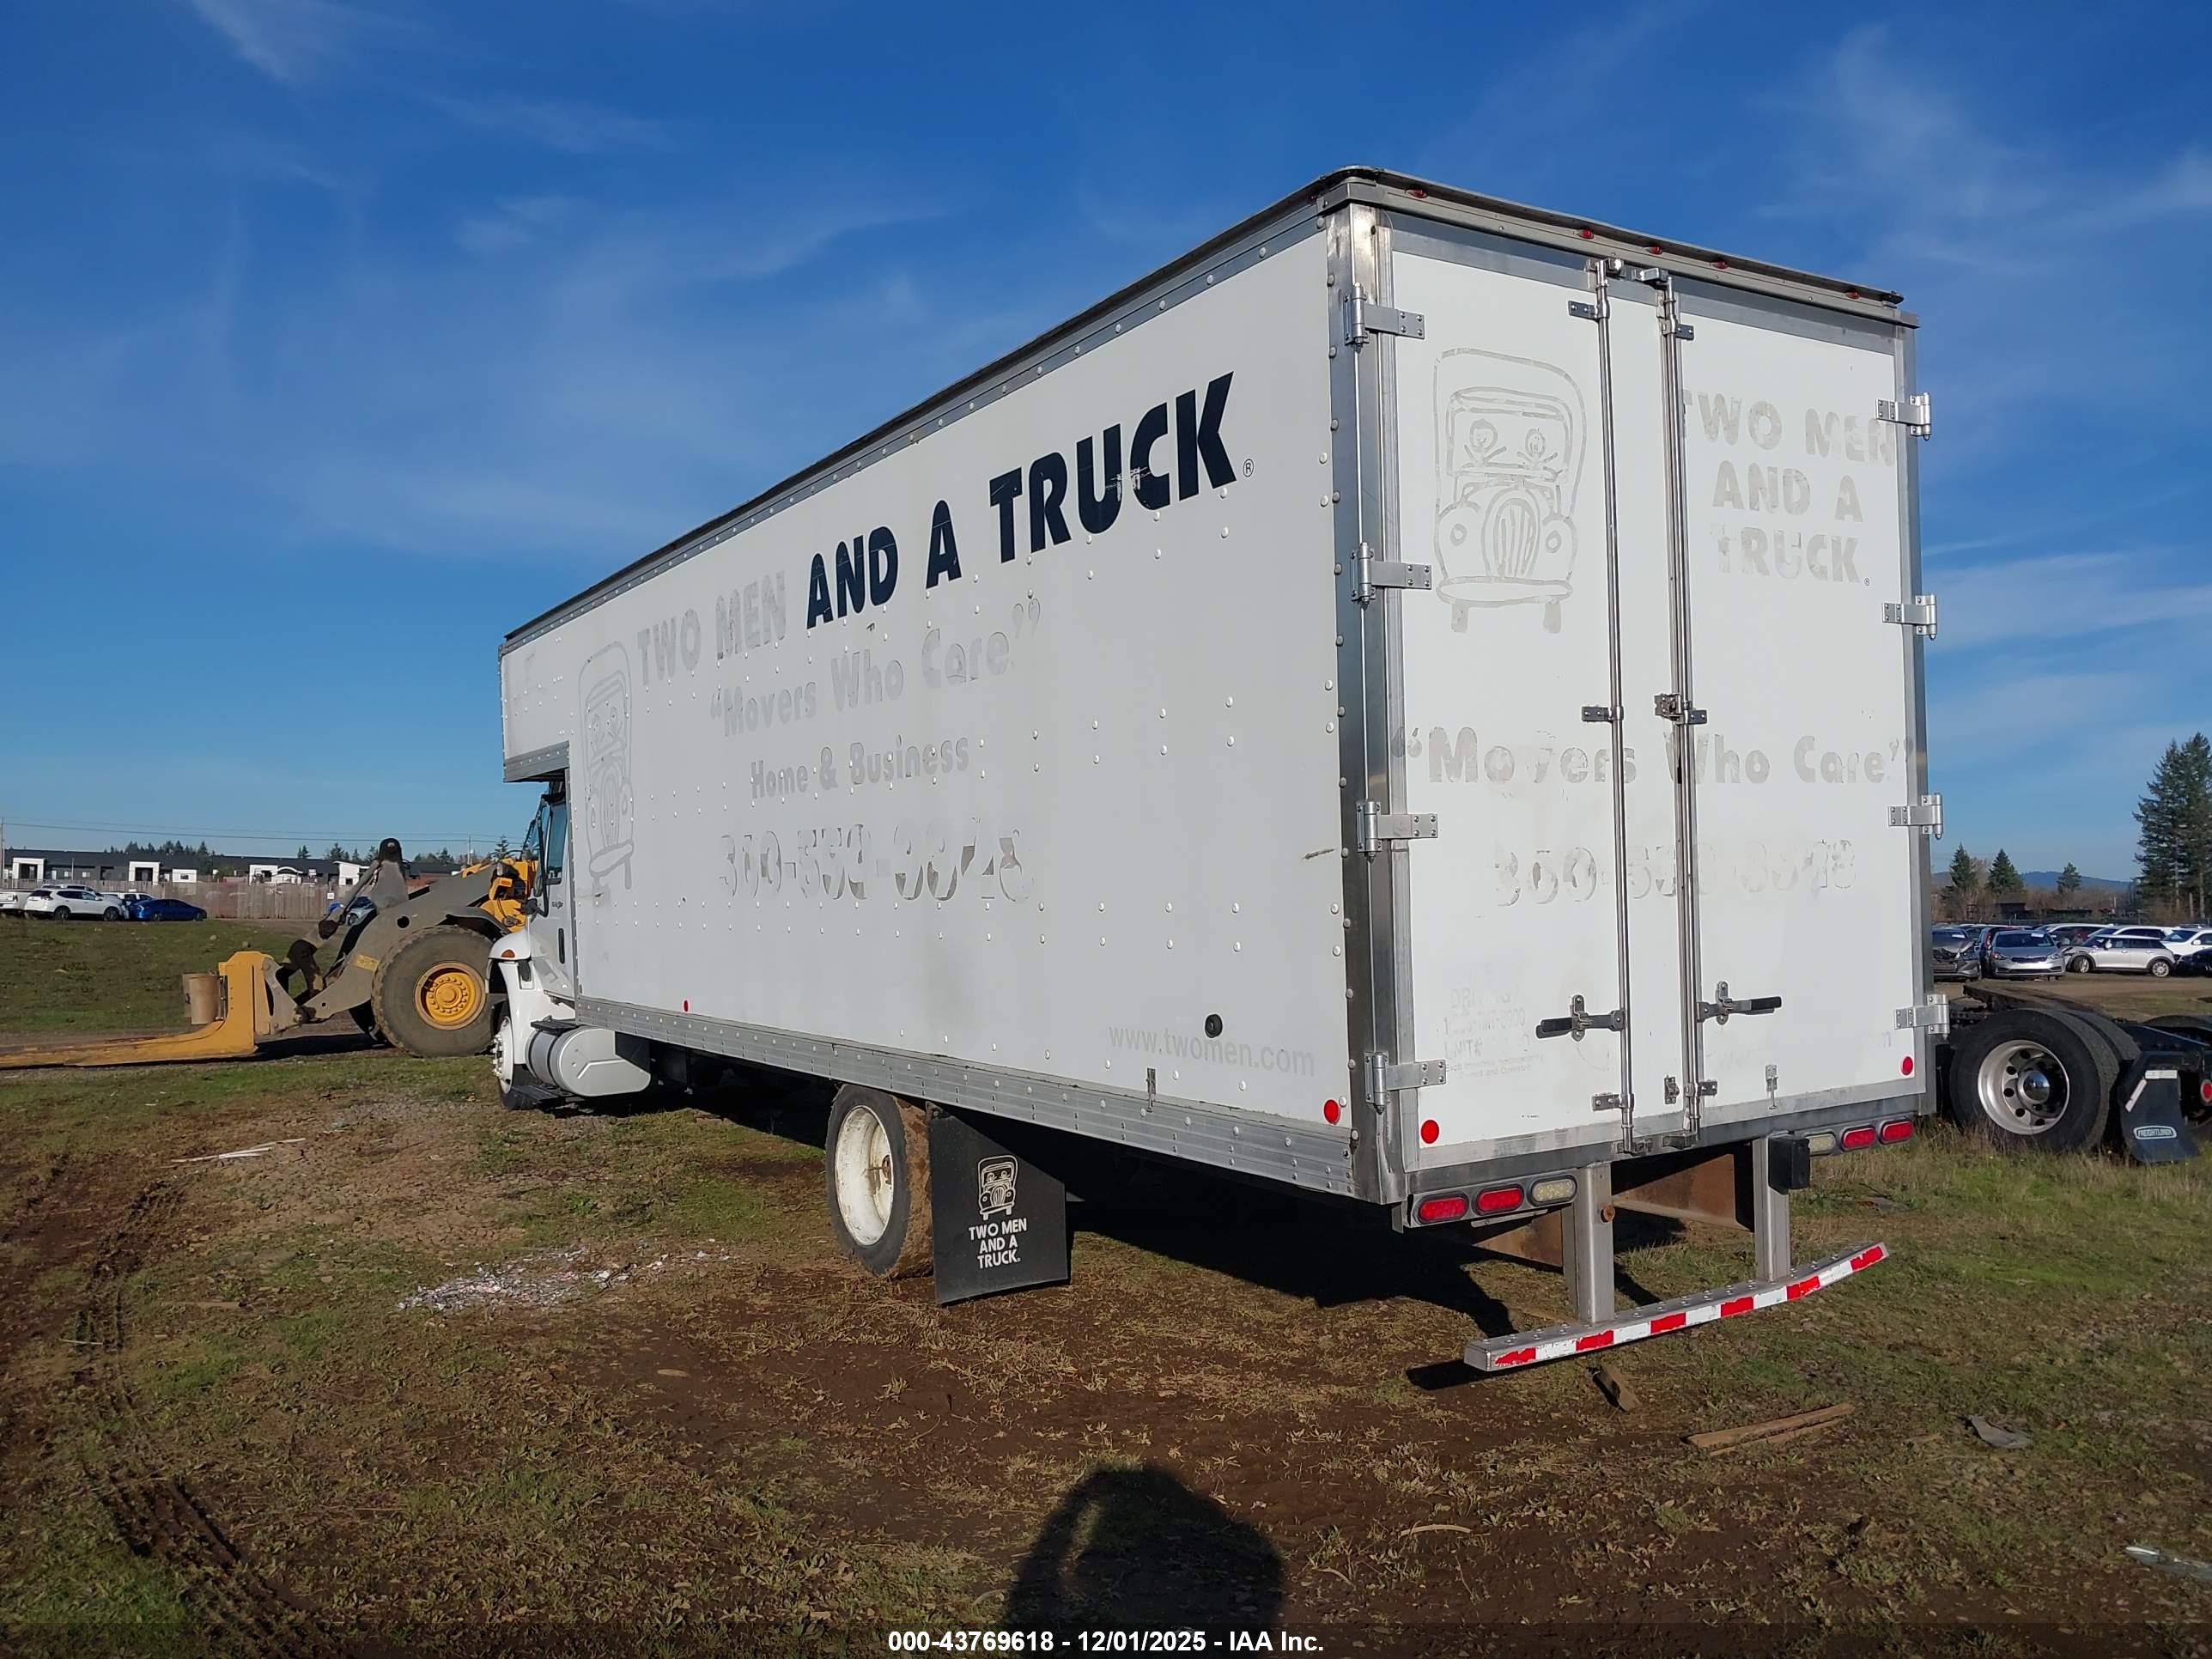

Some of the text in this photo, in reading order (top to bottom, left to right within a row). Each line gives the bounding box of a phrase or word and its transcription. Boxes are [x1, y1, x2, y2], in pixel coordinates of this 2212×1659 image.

[1805, 407, 1896, 467] MEN
[1712, 460, 1864, 523] AND A
[637, 608, 702, 686] TWO
[715, 571, 787, 659] MEN
[806, 526, 899, 629] AND
[926, 500, 962, 589] A
[830, 648, 904, 712] Who
[750, 735, 969, 799] Home & Business
[1109, 1027, 1316, 1077] www.twomen.com
[969, 1218, 1027, 1240] TWO MEN
[980, 1234, 1018, 1254] AND A
